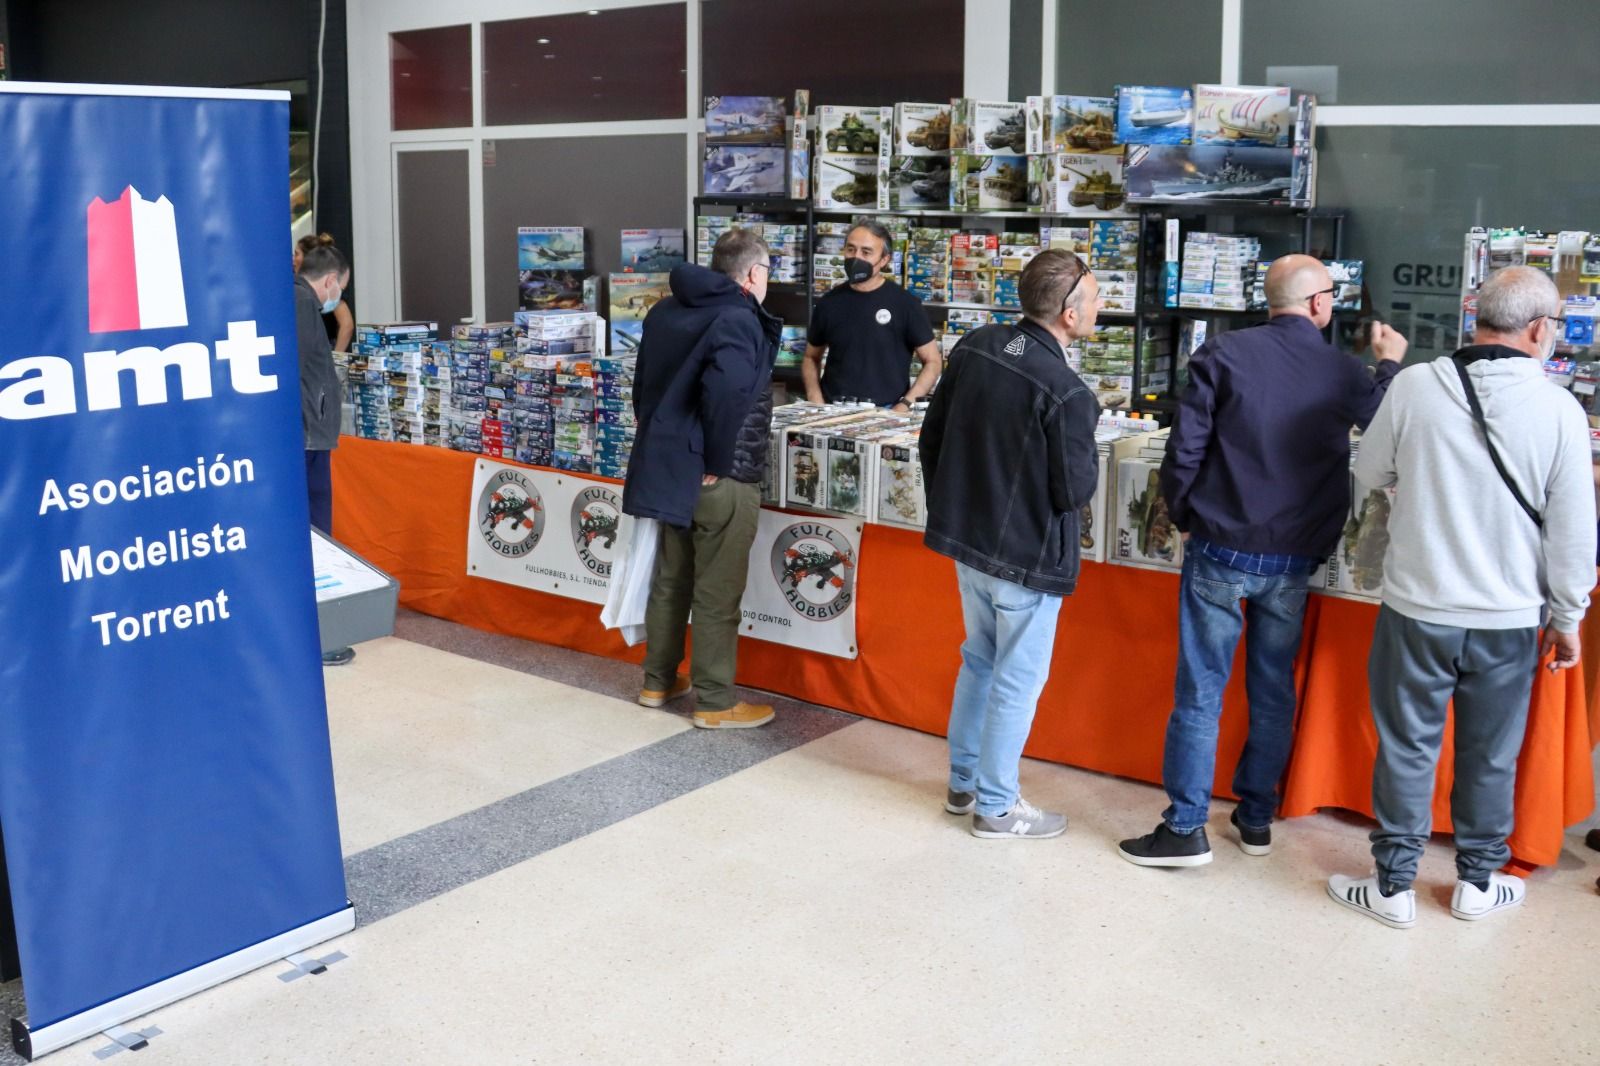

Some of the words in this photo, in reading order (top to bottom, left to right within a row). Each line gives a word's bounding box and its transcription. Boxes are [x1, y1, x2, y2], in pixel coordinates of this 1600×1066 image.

[0, 320, 278, 420] amt
[39, 454, 255, 515] Asociación
[498, 472, 528, 488] FULL
[584, 489, 617, 506] FULL
[484, 530, 539, 556] HOBBIES
[790, 525, 833, 541] FULL
[1120, 528, 1130, 558] BT-7
[60, 523, 247, 583] Modelista
[583, 577, 607, 588] TIENDA
[786, 589, 851, 618] HOBBIES
[91, 589, 230, 646] Torrent
[758, 613, 792, 627] CONTROL
